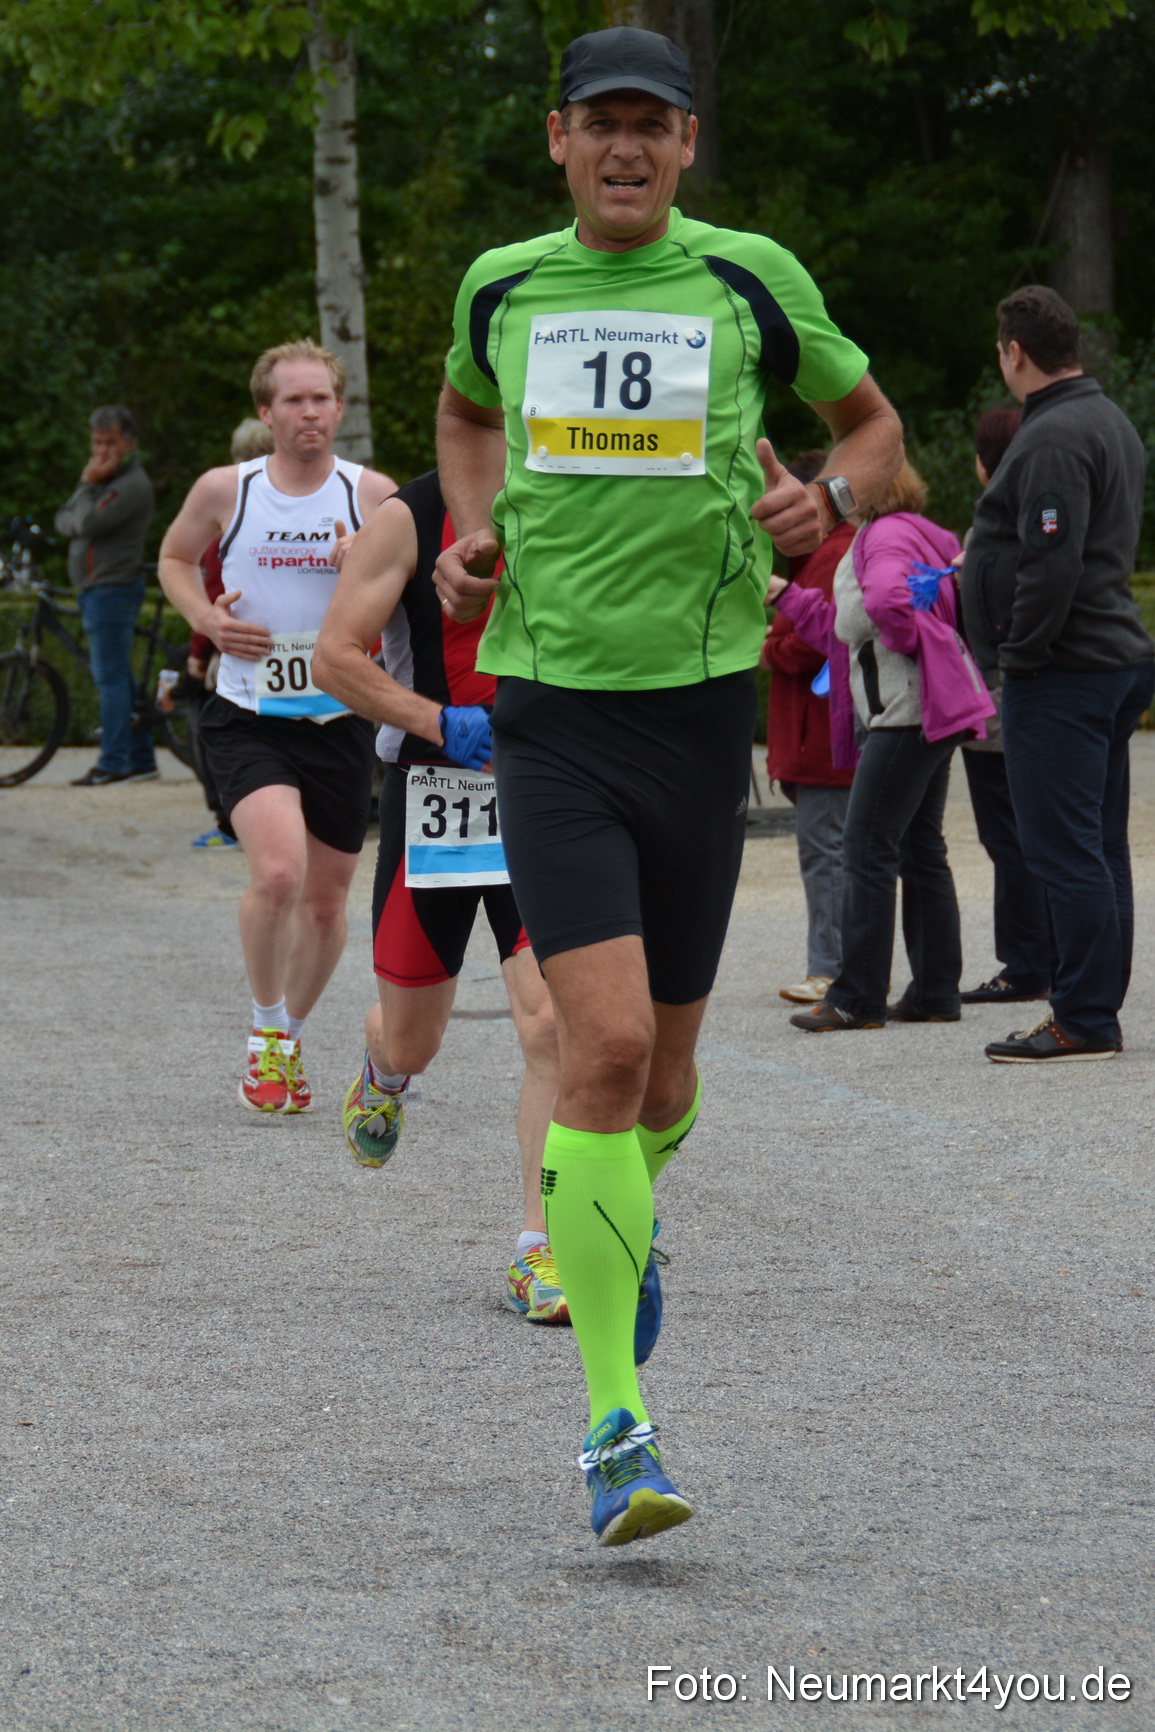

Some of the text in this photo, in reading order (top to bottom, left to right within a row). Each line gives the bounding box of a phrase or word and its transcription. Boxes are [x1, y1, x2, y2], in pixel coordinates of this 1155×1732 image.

[594, 327, 679, 345] Neumarkt
[582, 350, 653, 411] 18
[566, 426, 659, 452] Thomas
[265, 531, 331, 542] TEAM
[248, 545, 318, 558] guttenberger
[266, 656, 312, 693] 30
[411, 775, 497, 792] PARTL Neum
[421, 794, 498, 839] 311
